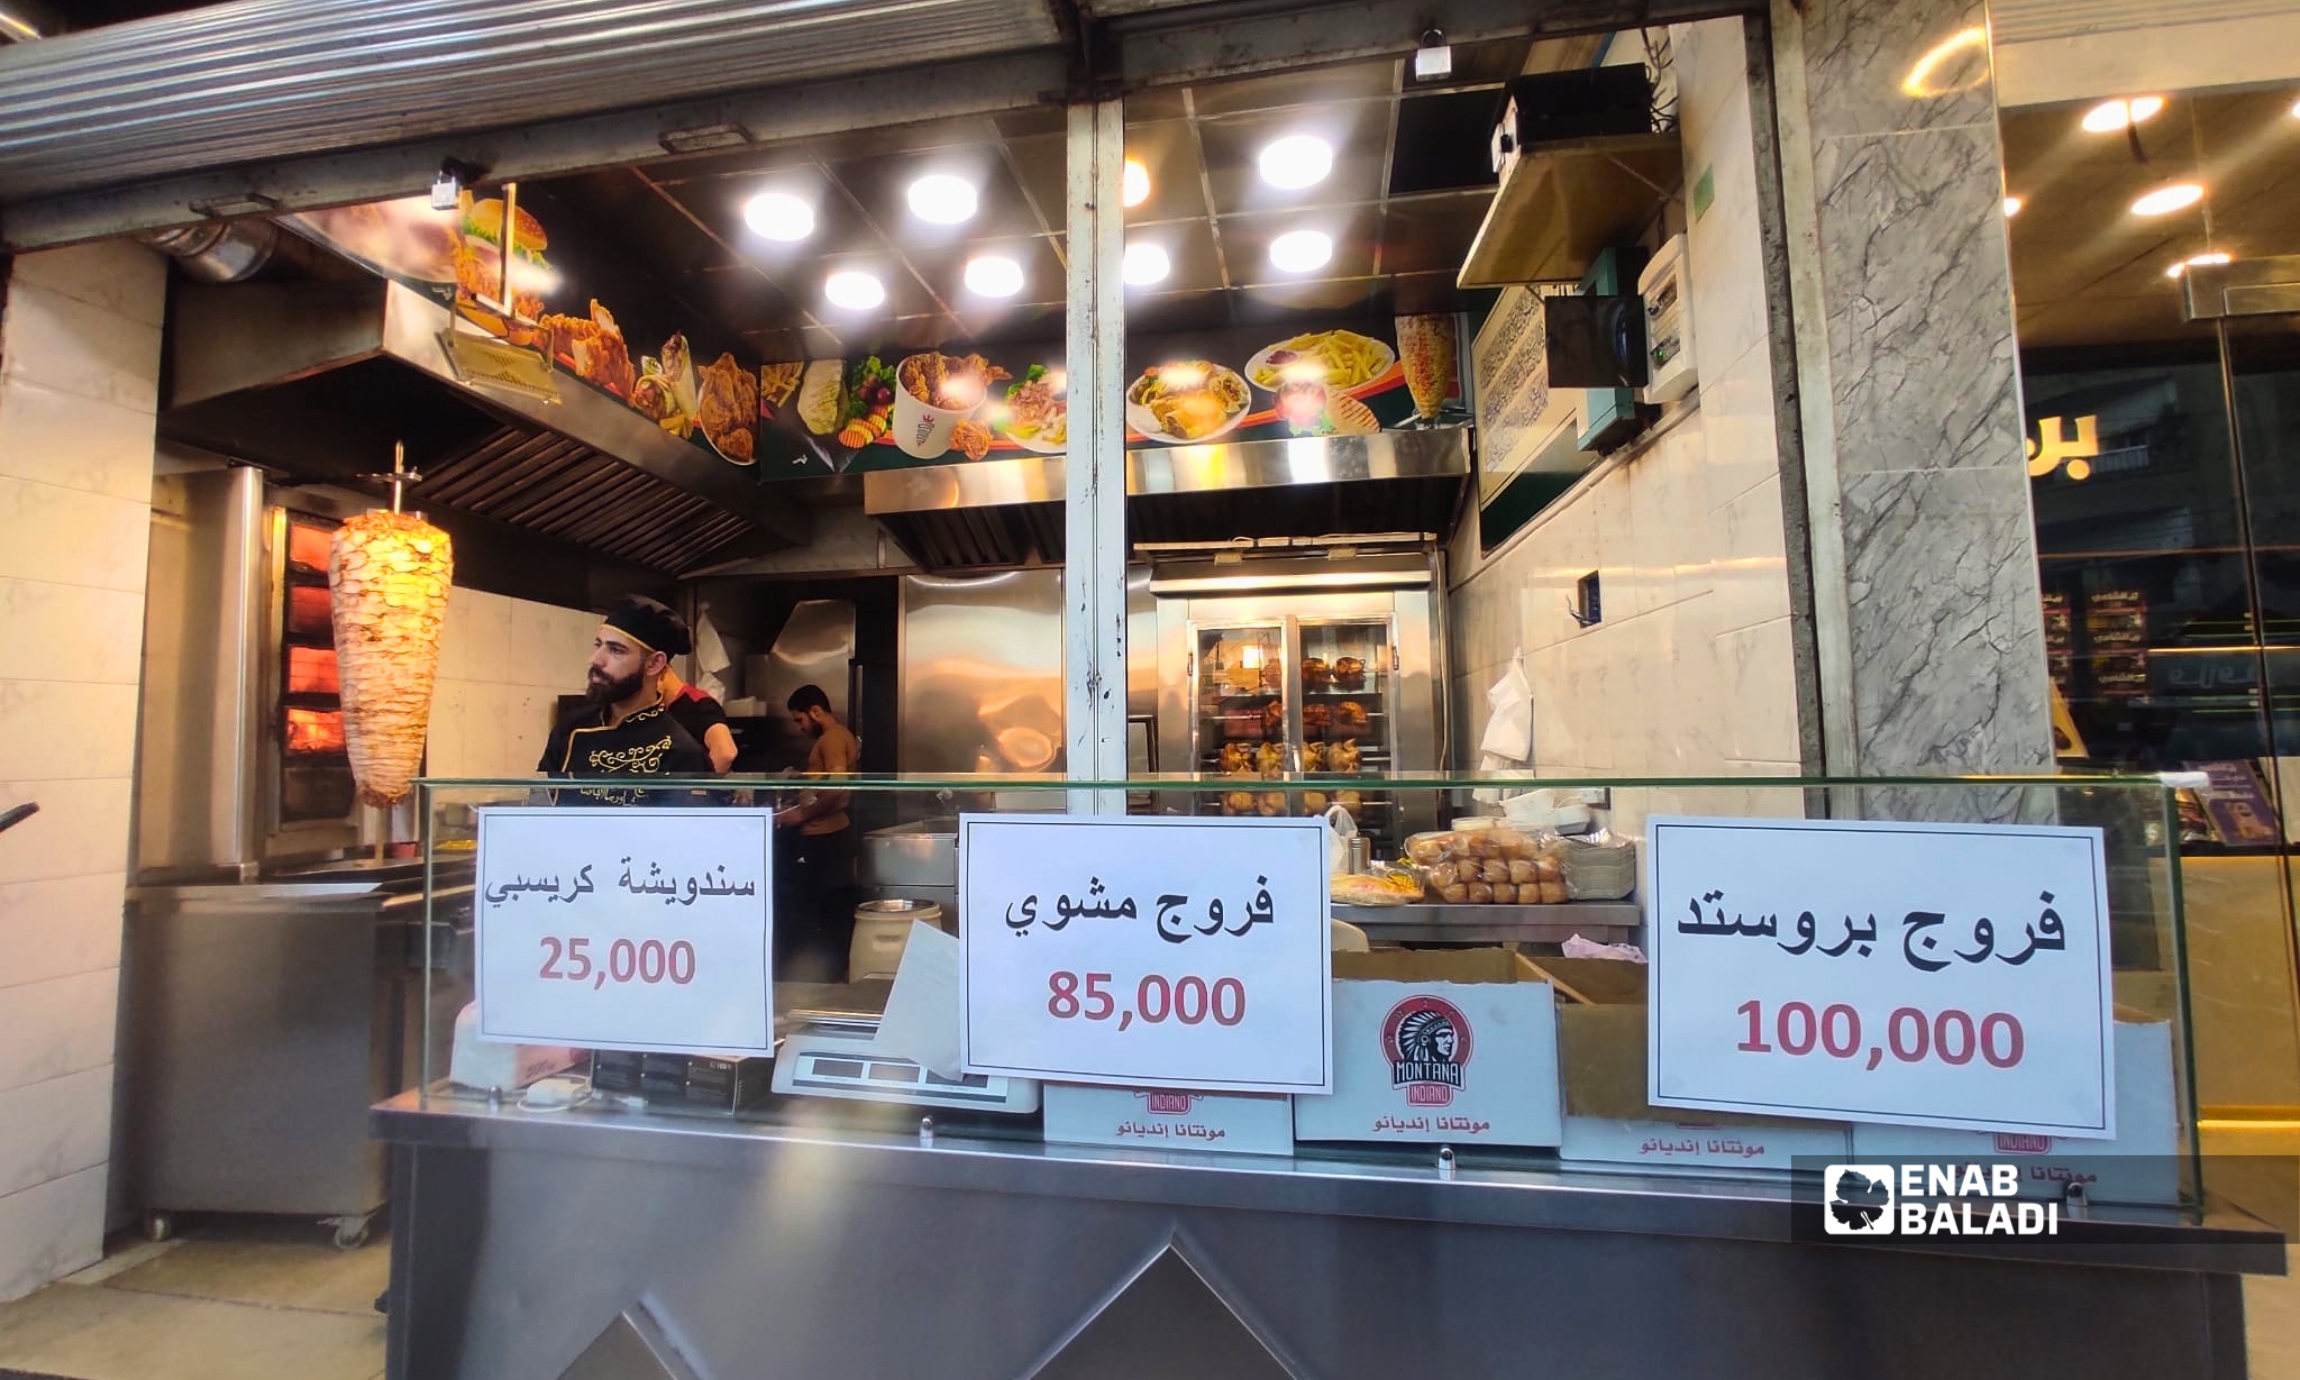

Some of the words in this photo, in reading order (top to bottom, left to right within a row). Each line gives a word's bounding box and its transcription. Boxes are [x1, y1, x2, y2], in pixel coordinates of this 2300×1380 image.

[485, 864, 594, 908] كريسبي
[618, 856, 755, 905] سندويشة
[1005, 876, 1138, 938] مشوي
[1156, 875, 1274, 944] فروج
[1677, 889, 1878, 958] بروستد
[1902, 890, 2065, 972] فروج
[539, 936, 696, 990] 25,000
[1048, 971, 1246, 1032] 85,000
[1737, 1000, 2025, 1070] 100,000
[1396, 1061, 1460, 1085] MONTANA
[1411, 1086, 1448, 1102] INDIANO
[1175, 1122, 1226, 1141] مونتانا
[1436, 1116, 1490, 1134] مونتانا
[1706, 1139, 1765, 1158] مونتانا
